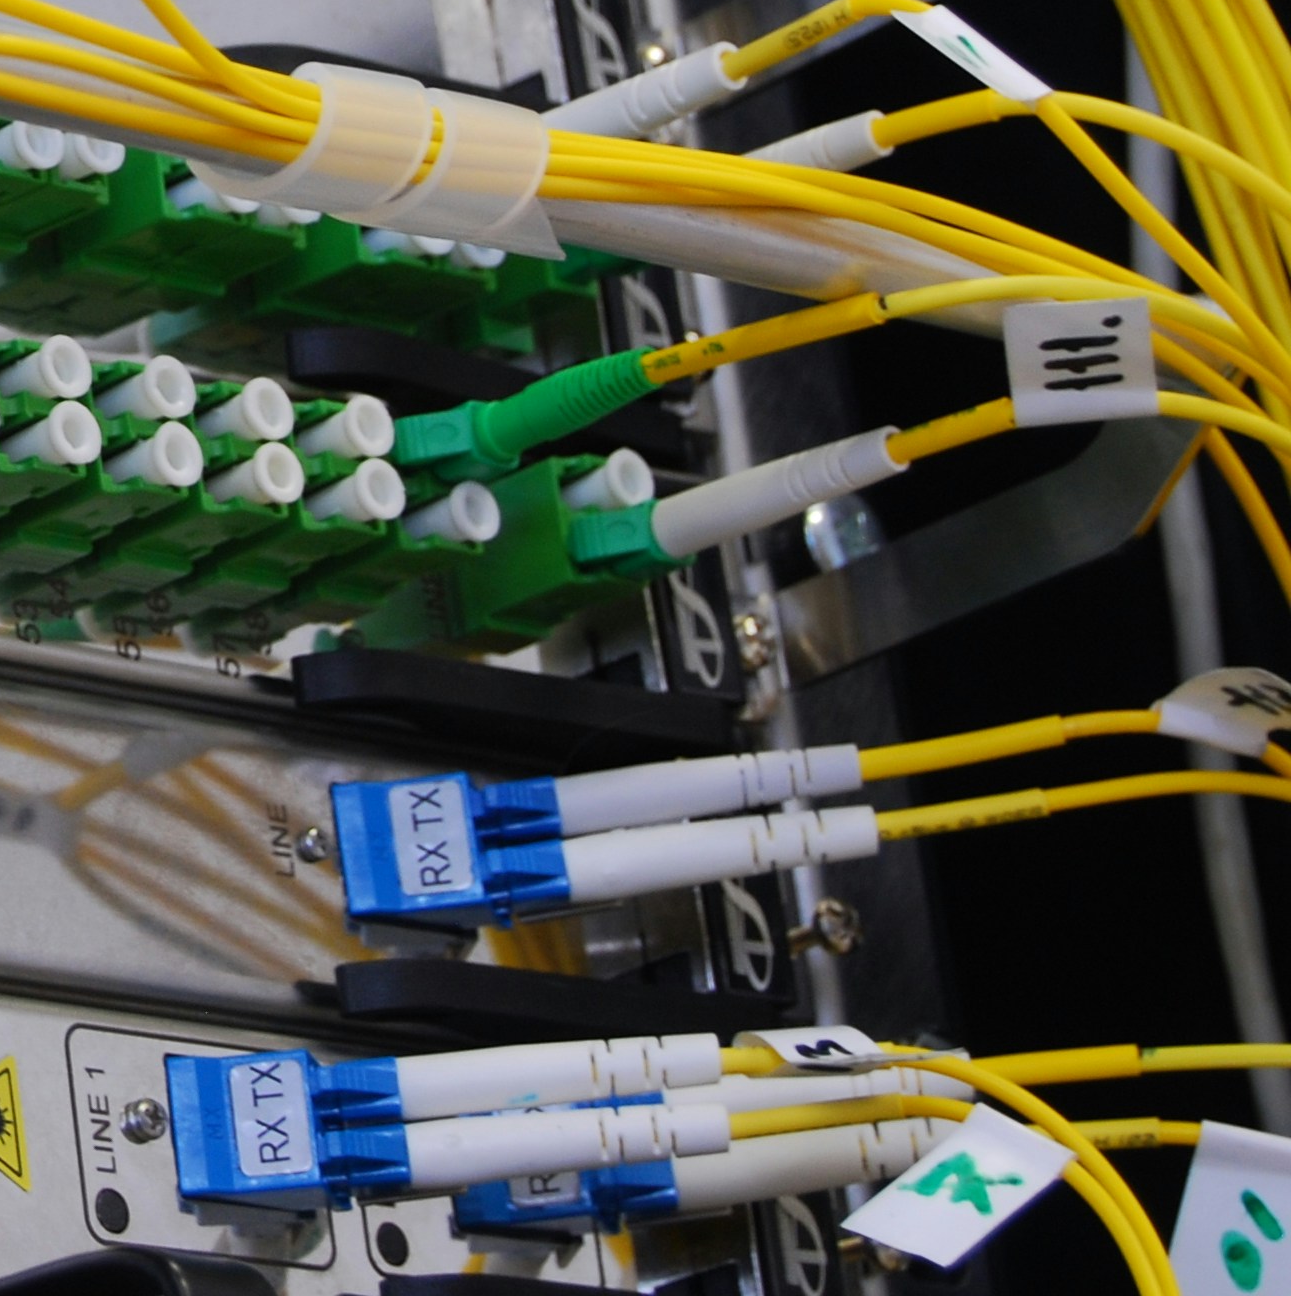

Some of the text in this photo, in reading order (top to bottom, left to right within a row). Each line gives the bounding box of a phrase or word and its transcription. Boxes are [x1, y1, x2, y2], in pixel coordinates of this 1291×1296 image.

[267, 804, 295, 878] LINE
[409, 787, 453, 887] RX TX
[84, 1066, 117, 1174] LINE 1
[249, 1062, 291, 1164] RX TX
